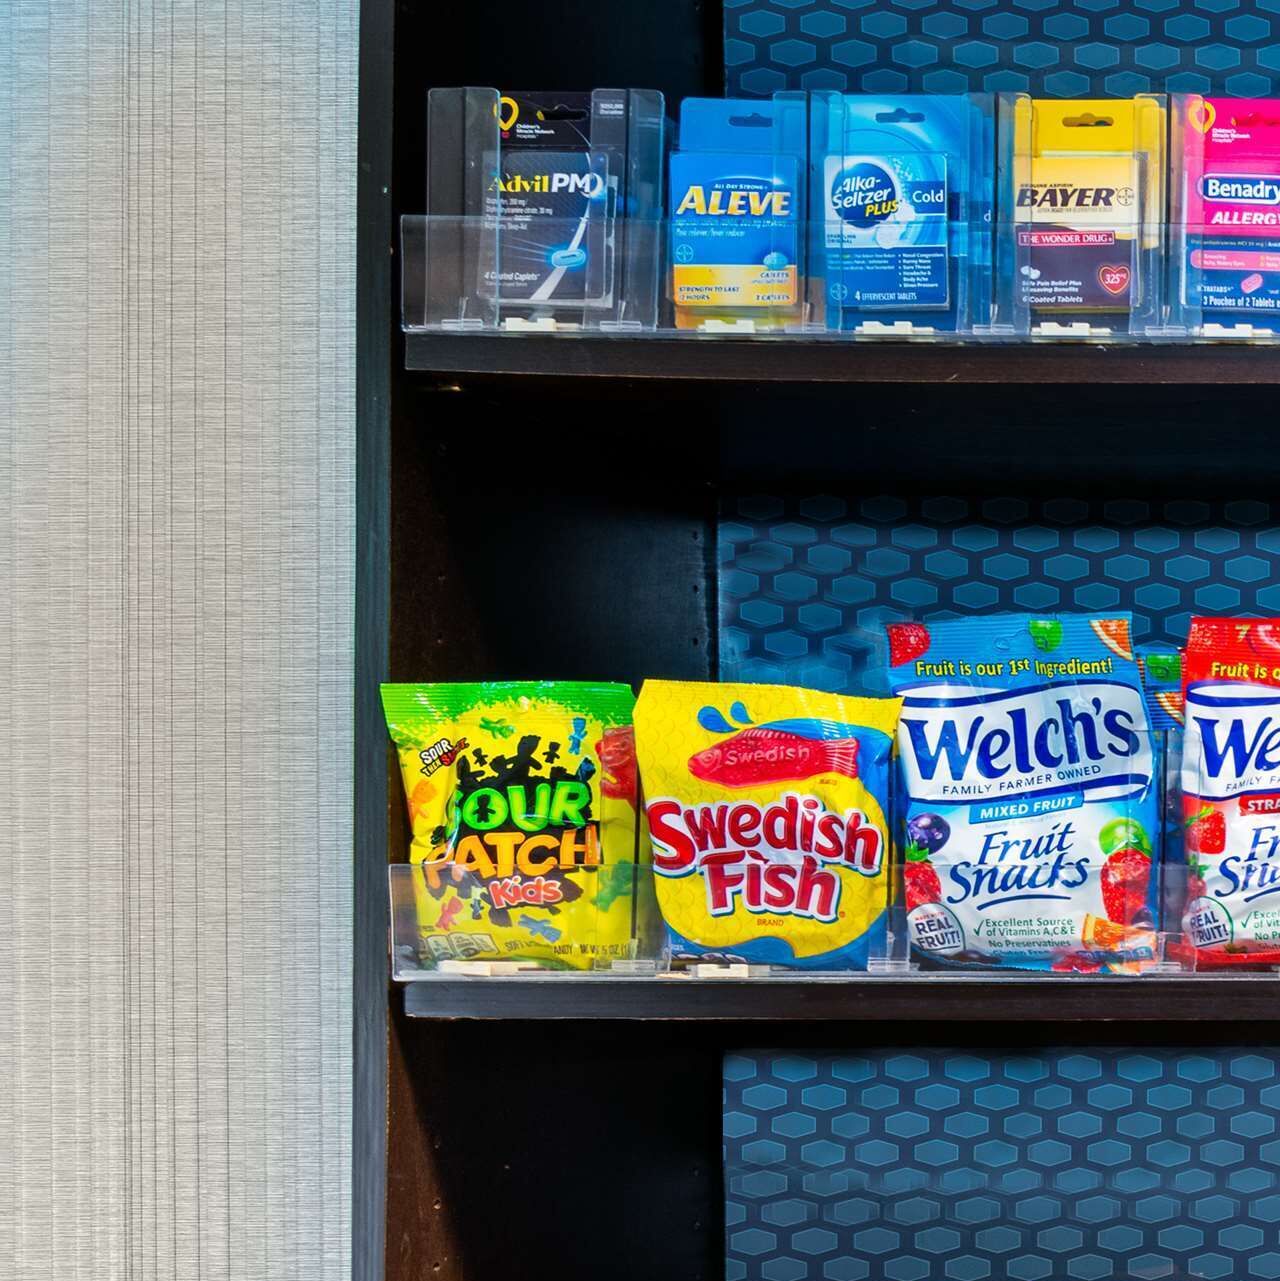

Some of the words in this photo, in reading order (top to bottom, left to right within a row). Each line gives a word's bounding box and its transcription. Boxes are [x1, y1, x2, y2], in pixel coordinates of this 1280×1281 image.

[488, 173, 550, 193] Advil
[551, 173, 594, 193] PM
[835, 176, 881, 193] Alka-
[676, 185, 792, 216] ALEVE
[831, 188, 890, 209] Seltzer
[865, 200, 899, 216] PLUS
[912, 190, 944, 203] Cold
[1017, 187, 1117, 208] BAYER
[915, 661, 955, 677] Fruit
[959, 660, 971, 676] is
[976, 662, 1002, 676] our
[1008, 659, 1030, 676] 1st
[1035, 657, 1113, 678] Ingredient!
[900, 697, 1141, 781] Welch's
[727, 747, 810, 766] Swedish
[942, 784, 992, 796] FAMILY
[1000, 774, 1052, 791] FARMER
[1057, 764, 1102, 780] OWNED
[446, 783, 589, 836] SOUR
[980, 804, 1030, 819] MIXED
[1034, 796, 1075, 813] FRUIT
[647, 800, 881, 873] Swedish
[978, 822, 1076, 865] Fruit
[425, 824, 599, 889] PATCH
[489, 876, 563, 909] Kids
[700, 849, 839, 920] Fish
[757, 918, 784, 928] BRAND
